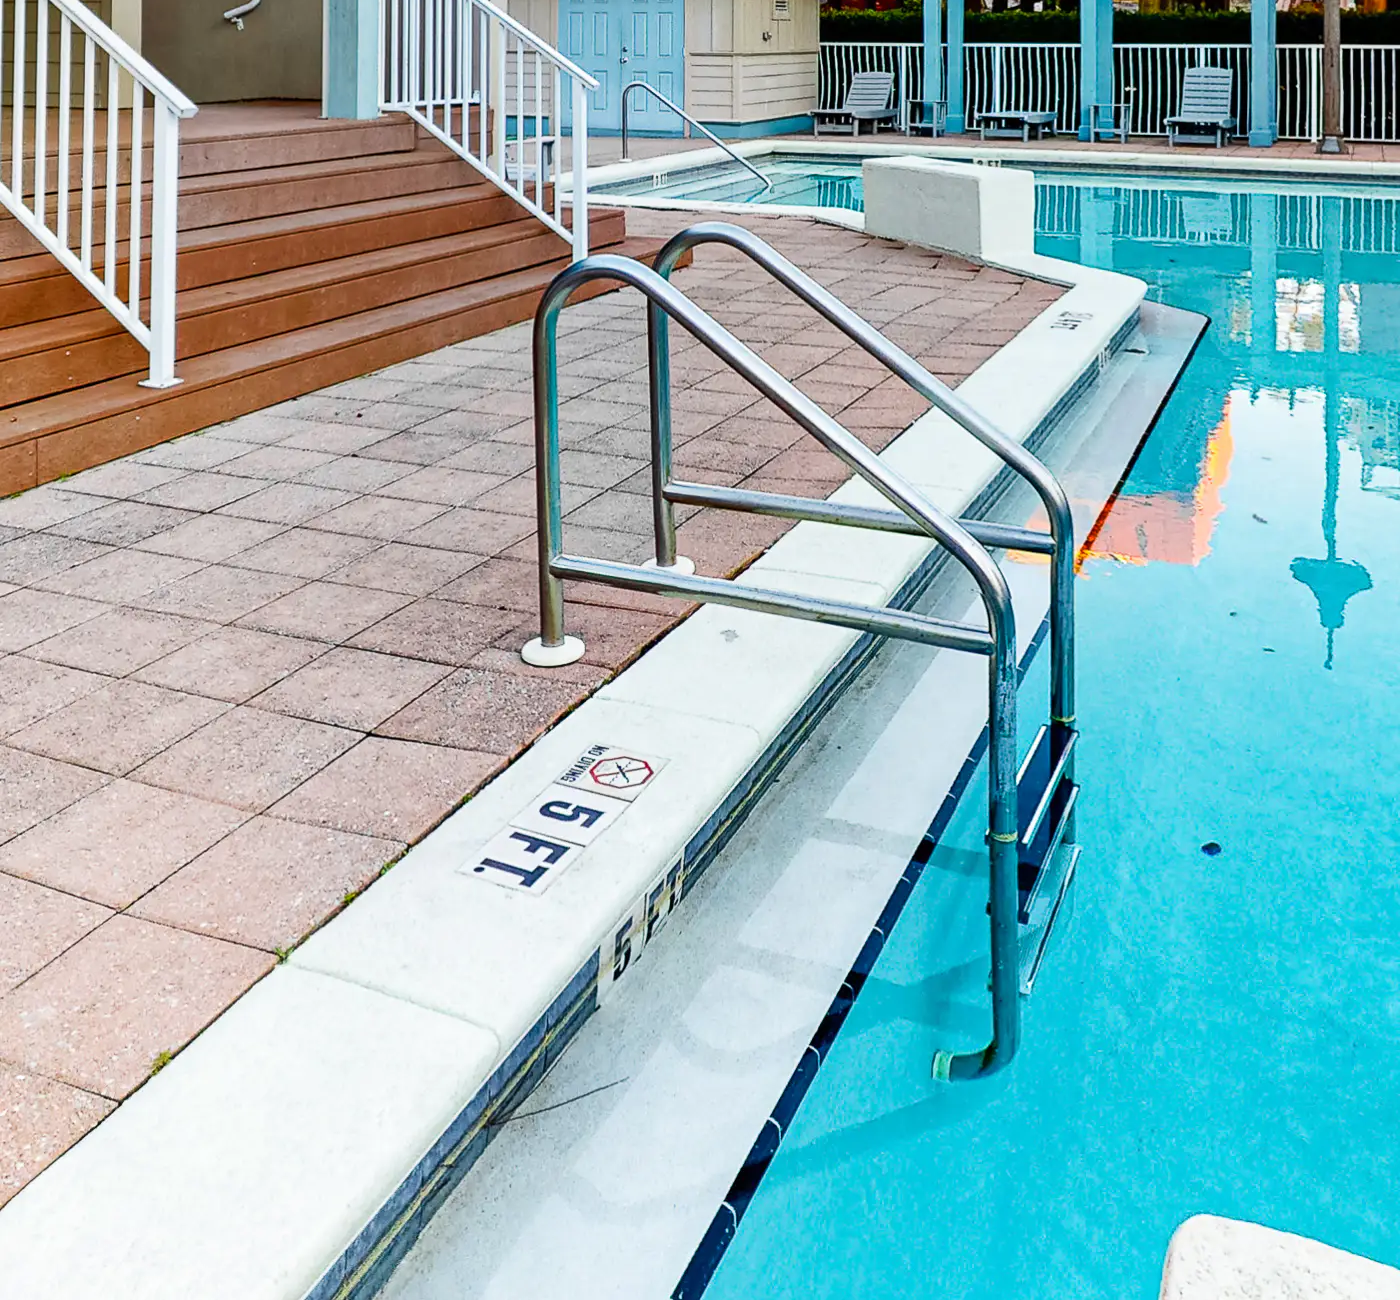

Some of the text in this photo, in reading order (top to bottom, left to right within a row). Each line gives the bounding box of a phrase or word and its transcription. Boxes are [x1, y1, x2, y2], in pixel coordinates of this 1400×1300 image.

[560, 745, 609, 783] NO DIVING
[473, 800, 605, 888] 5 FT.
[613, 916, 633, 981] 5
